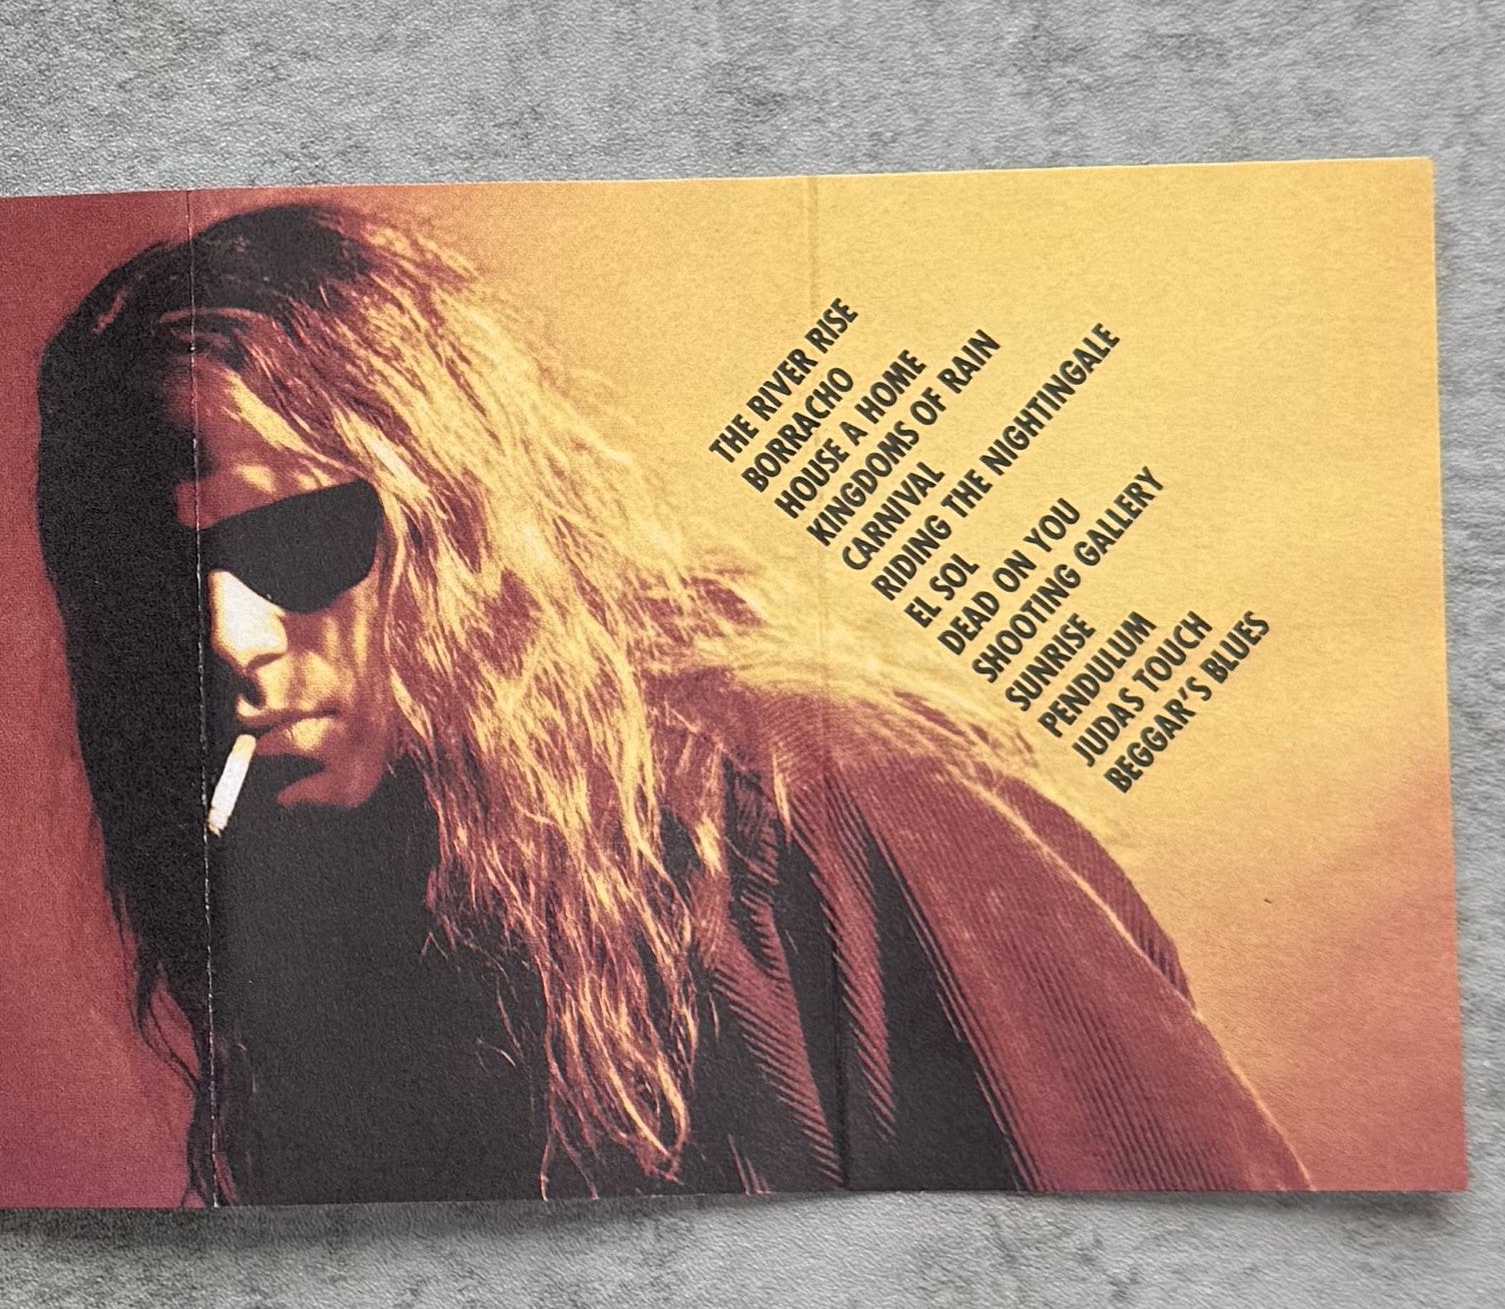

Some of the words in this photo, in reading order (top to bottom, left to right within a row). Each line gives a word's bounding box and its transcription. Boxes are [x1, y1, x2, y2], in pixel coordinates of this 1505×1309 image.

[709, 413, 760, 463] THE
[746, 348, 819, 422] RIVER
[804, 297, 859, 354] RISE
[741, 367, 854, 493] BORRACHO
[774, 437, 850, 519] HOUSE
[839, 421, 869, 447] A
[854, 349, 927, 425] HOME
[806, 420, 920, 547] KINGDOMS
[910, 386, 947, 426] OF
[936, 329, 1001, 394] RAIN
[842, 461, 945, 571] CARNIVAL
[871, 514, 952, 601] RIDING
[941, 469, 993, 518] THE
[979, 323, 1121, 476] NIGHTINGALE
[904, 596, 942, 628] EL
[929, 553, 980, 601] SOL
[937, 591, 1000, 656] DEAD
[993, 549, 1037, 593] ON
[1023, 497, 1081, 553] YOU
[972, 564, 1081, 684] SHOOTING
[1074, 466, 1164, 566] GALLERY
[1005, 613, 1096, 712] SUNRISE
[1037, 611, 1157, 738] PENDULUM
[1072, 687, 1145, 768] JUDAS
[1132, 610, 1213, 693] TOUCH
[1103, 676, 1213, 794] BEGGAR'S
[1199, 610, 1270, 684] BLUES
